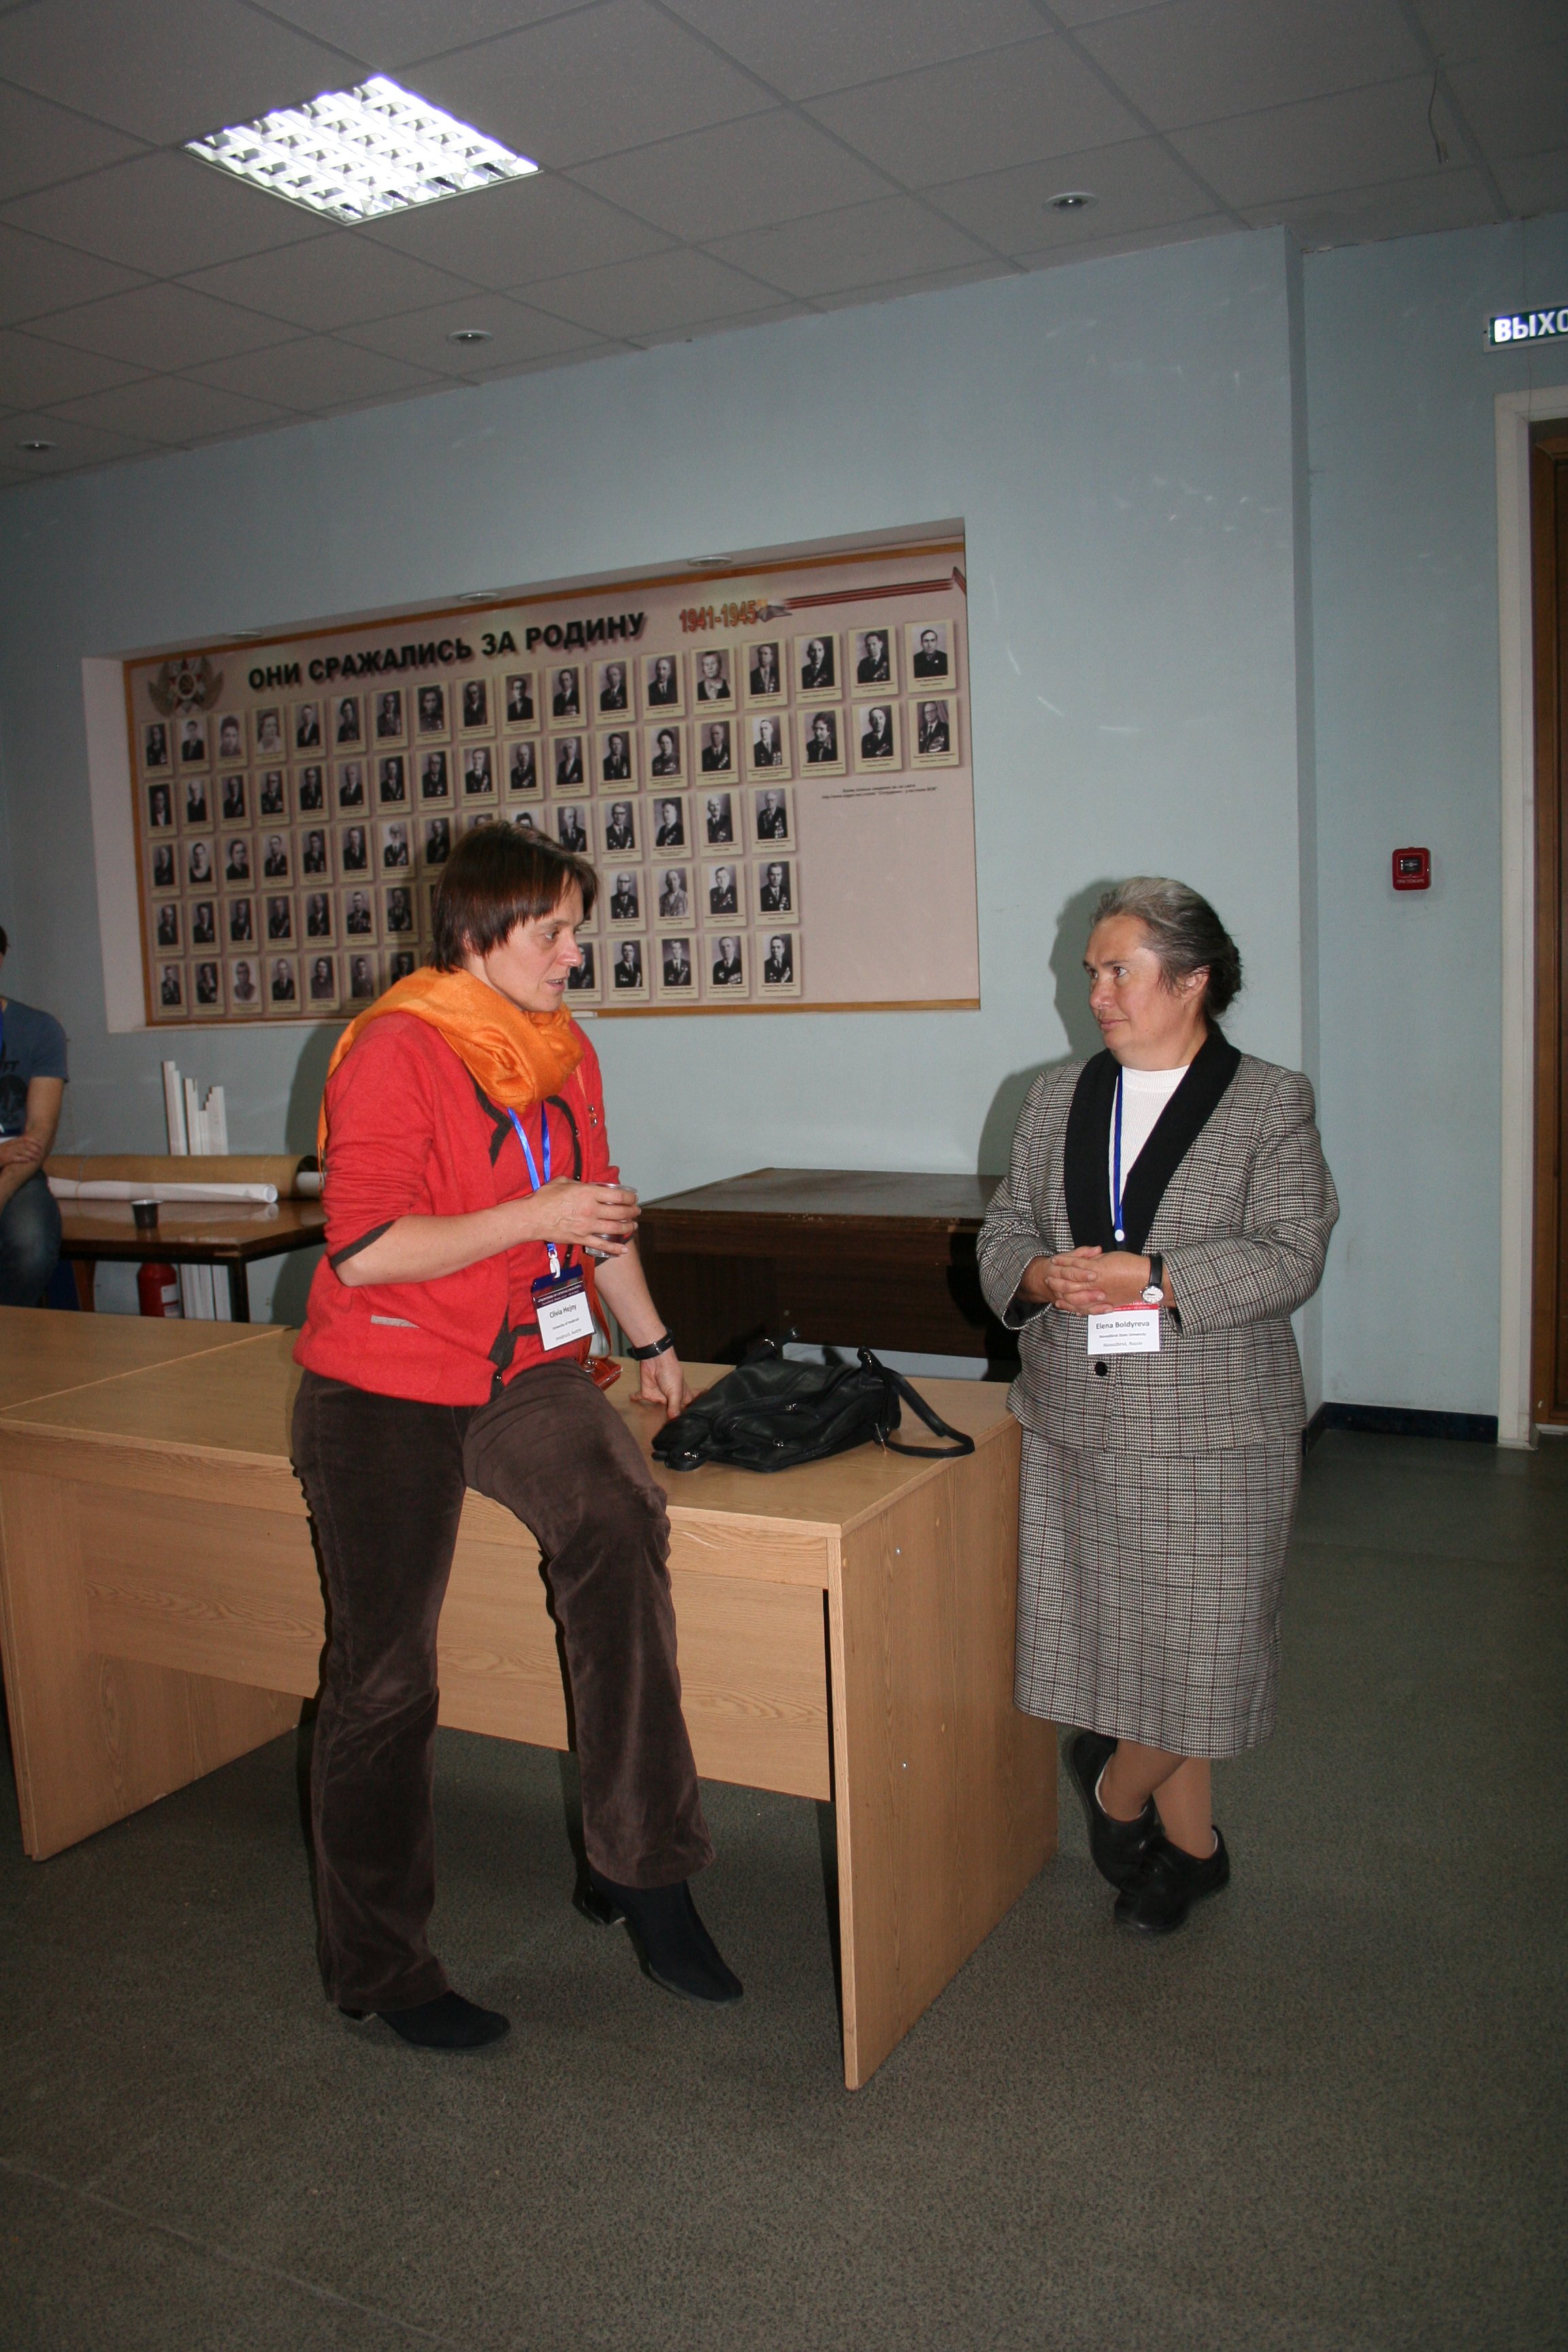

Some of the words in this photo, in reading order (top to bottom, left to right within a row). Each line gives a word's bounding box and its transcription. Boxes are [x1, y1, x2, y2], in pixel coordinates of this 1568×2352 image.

[679, 600, 757, 632] 1941-1945
[248, 663, 299, 689] ОНИ
[308, 638, 472, 681] СРАЖАЛИСЬ
[481, 630, 517, 656] ЗА
[526, 612, 644, 650] РОДИНУ
[1115, 1320, 1149, 1328] Boldyreva
